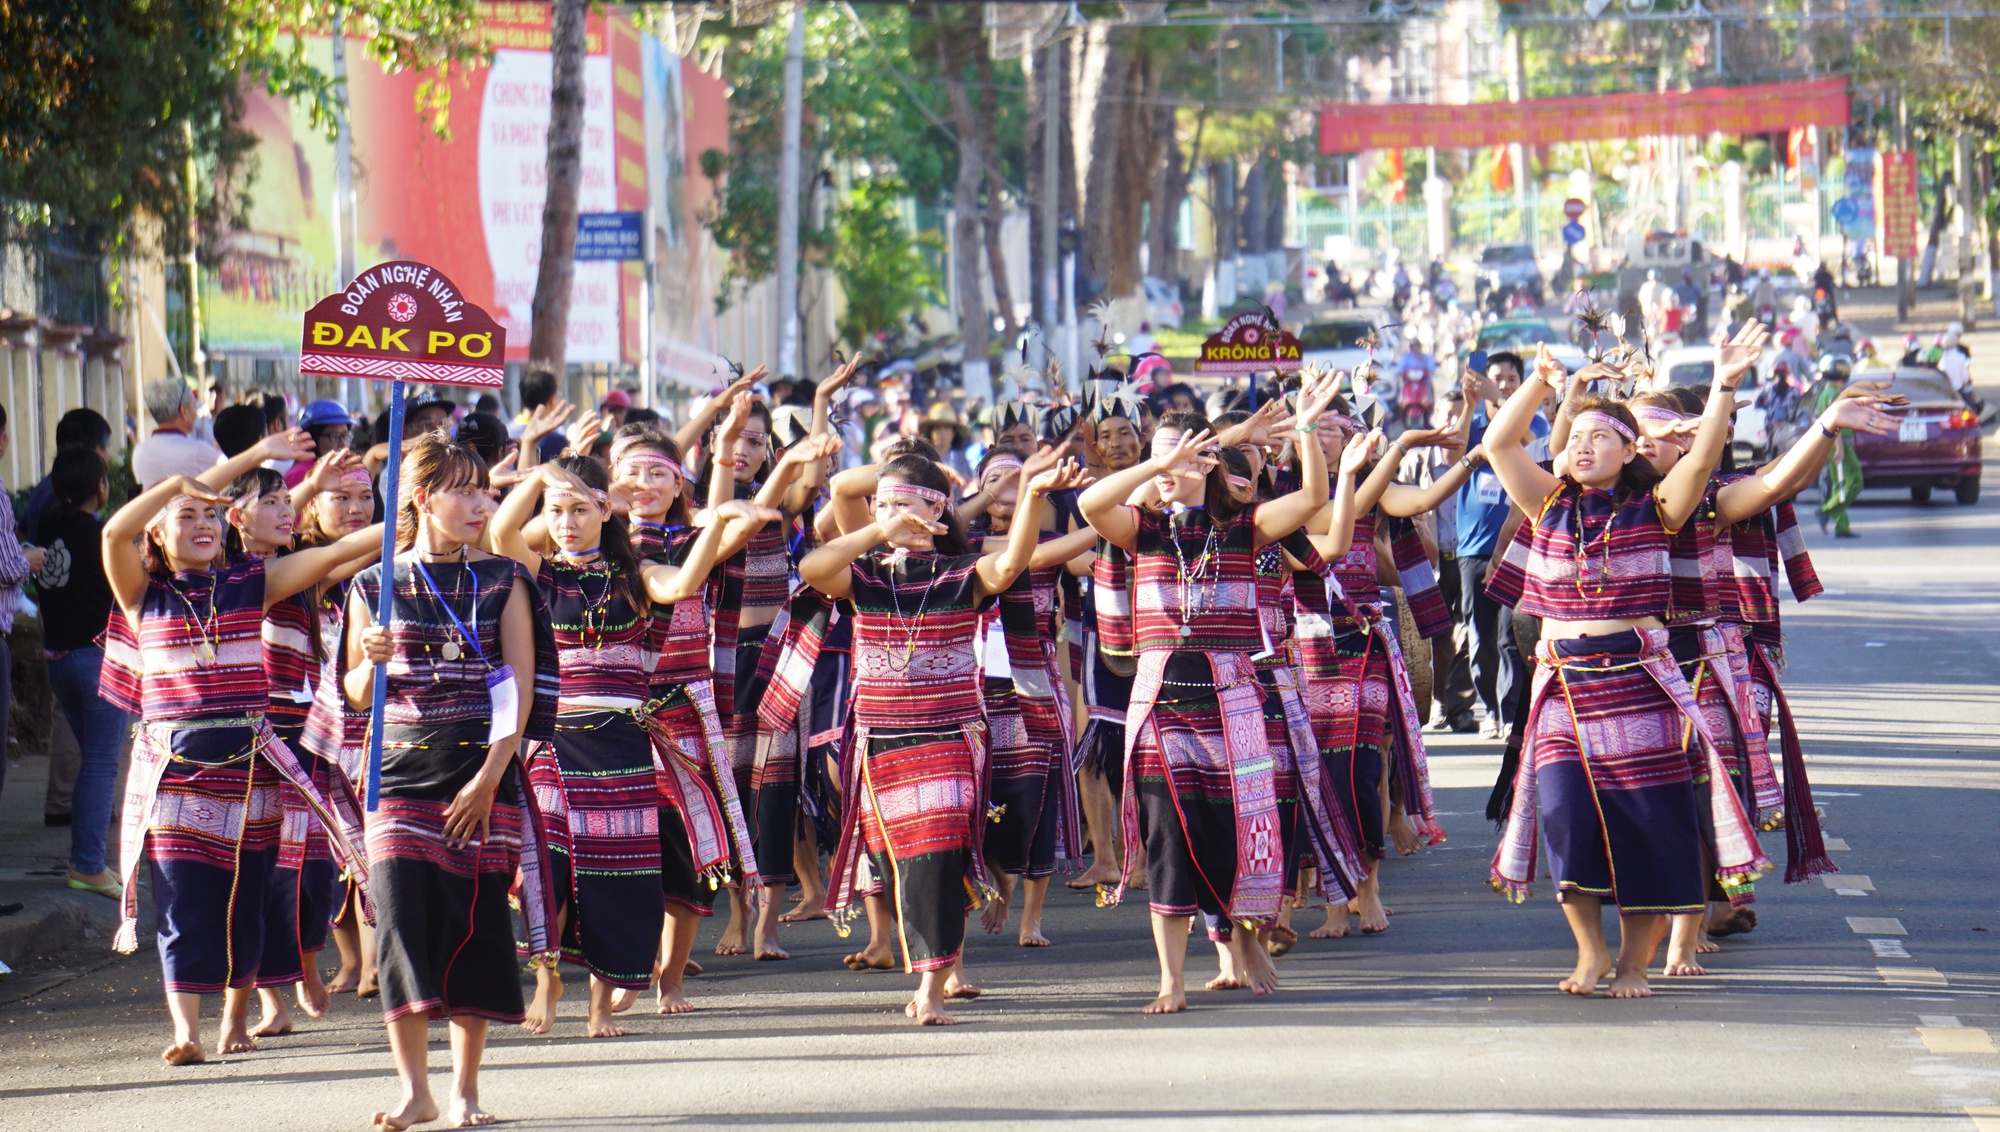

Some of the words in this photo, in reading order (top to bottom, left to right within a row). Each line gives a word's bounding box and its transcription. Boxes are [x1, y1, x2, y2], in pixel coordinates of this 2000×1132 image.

[341, 273, 380, 316] ĐOÀN
[381, 265, 430, 289] NGHỆ
[428, 278, 464, 323] NHÂN
[312, 322, 411, 352] ĐAK
[428, 331, 492, 358] PƠ
[1207, 343, 1270, 360] KRÔNG
